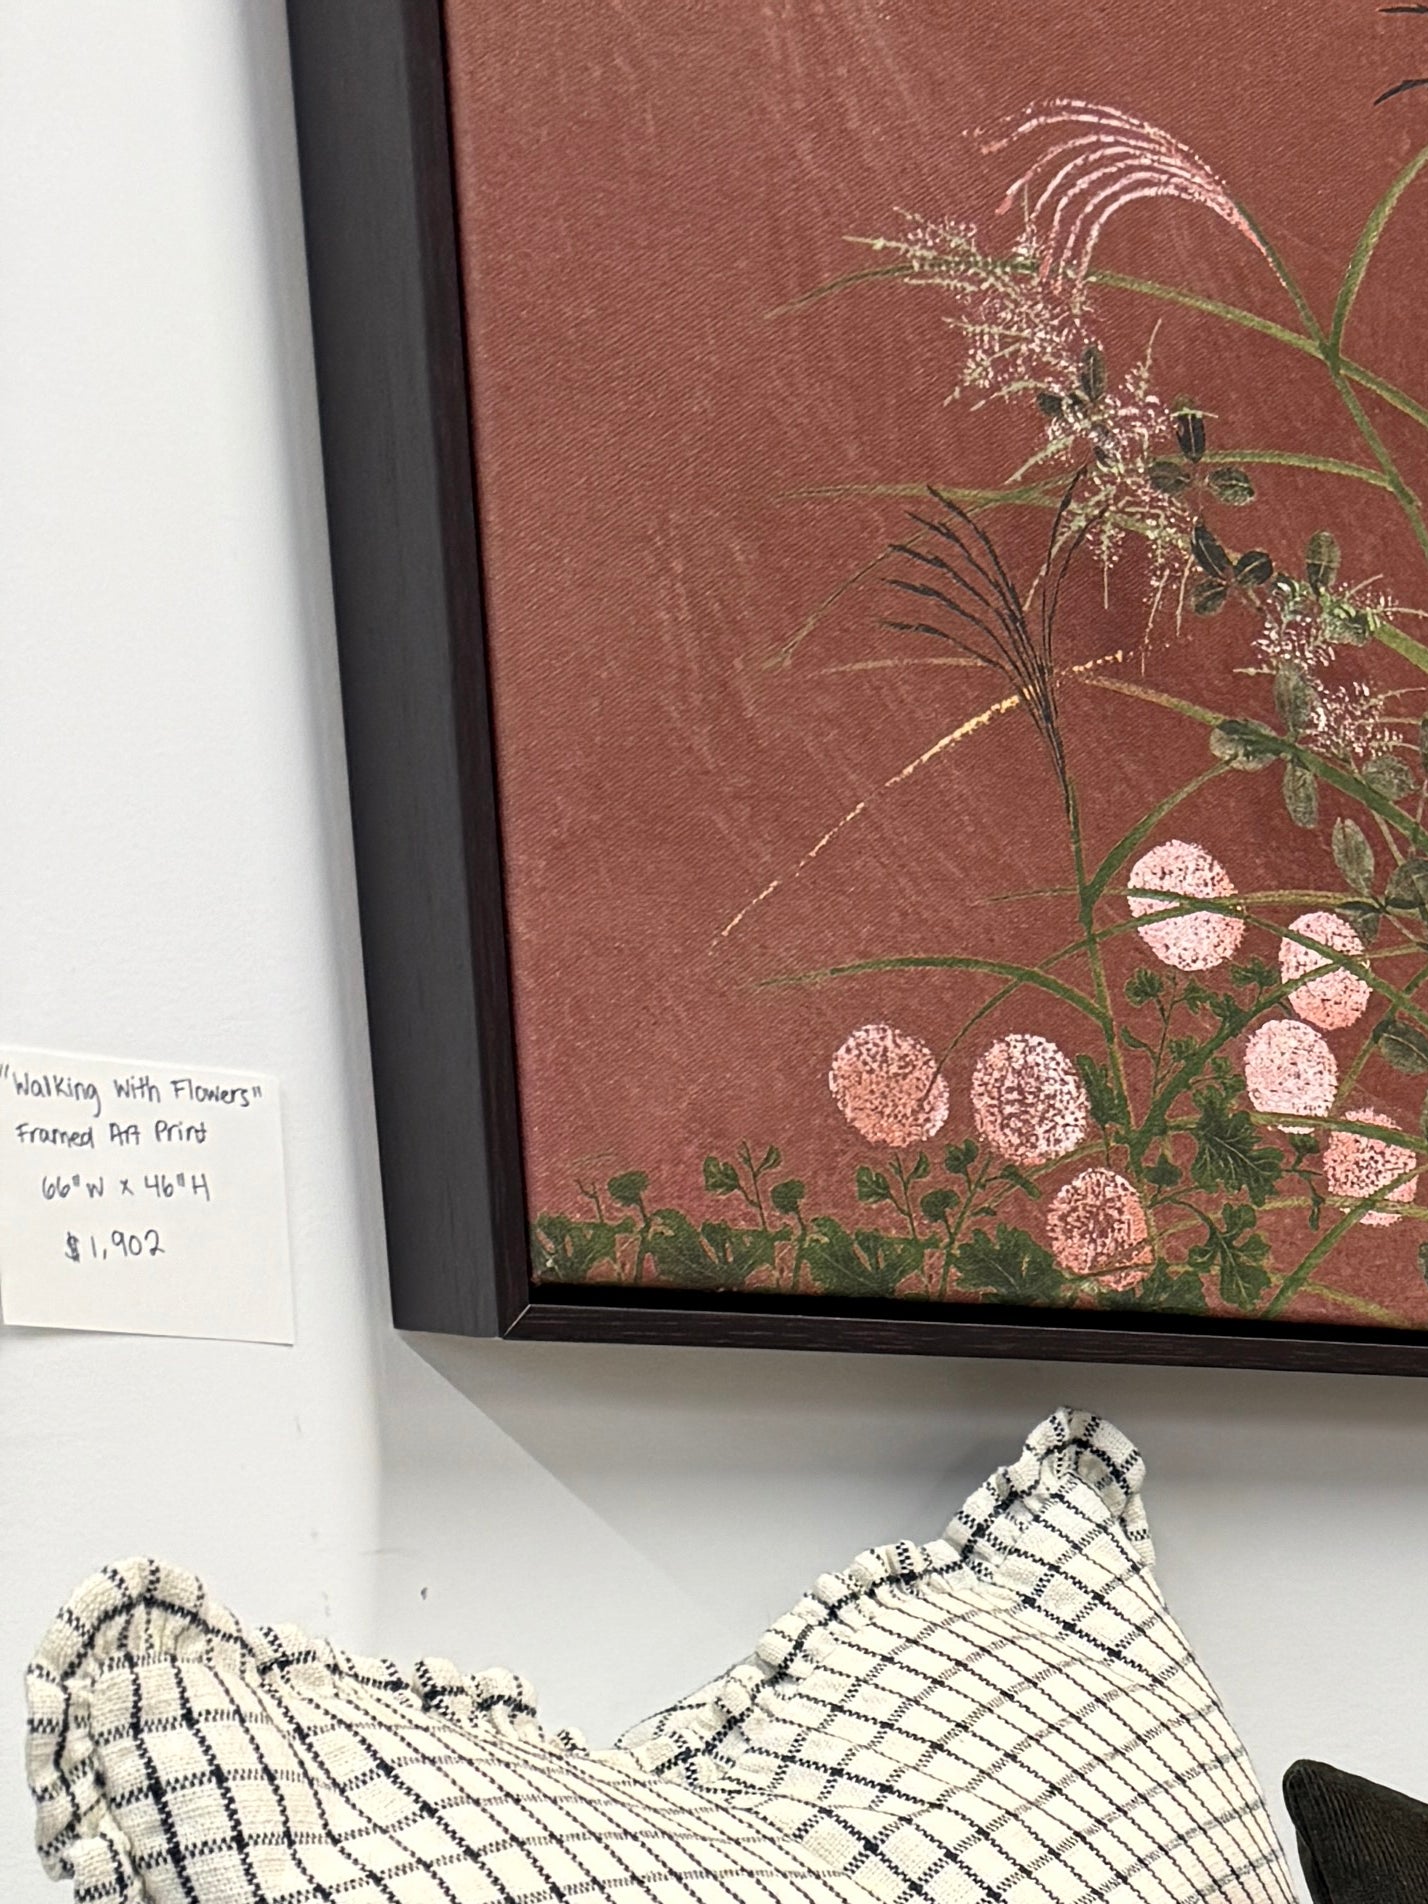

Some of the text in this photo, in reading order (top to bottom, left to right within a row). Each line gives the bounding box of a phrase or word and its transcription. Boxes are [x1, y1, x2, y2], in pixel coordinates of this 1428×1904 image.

[170, 1078, 262, 1107] Flowers"
[15, 1119, 207, 1149] Framed Art Print
[64, 1229, 166, 1263] $1,902
